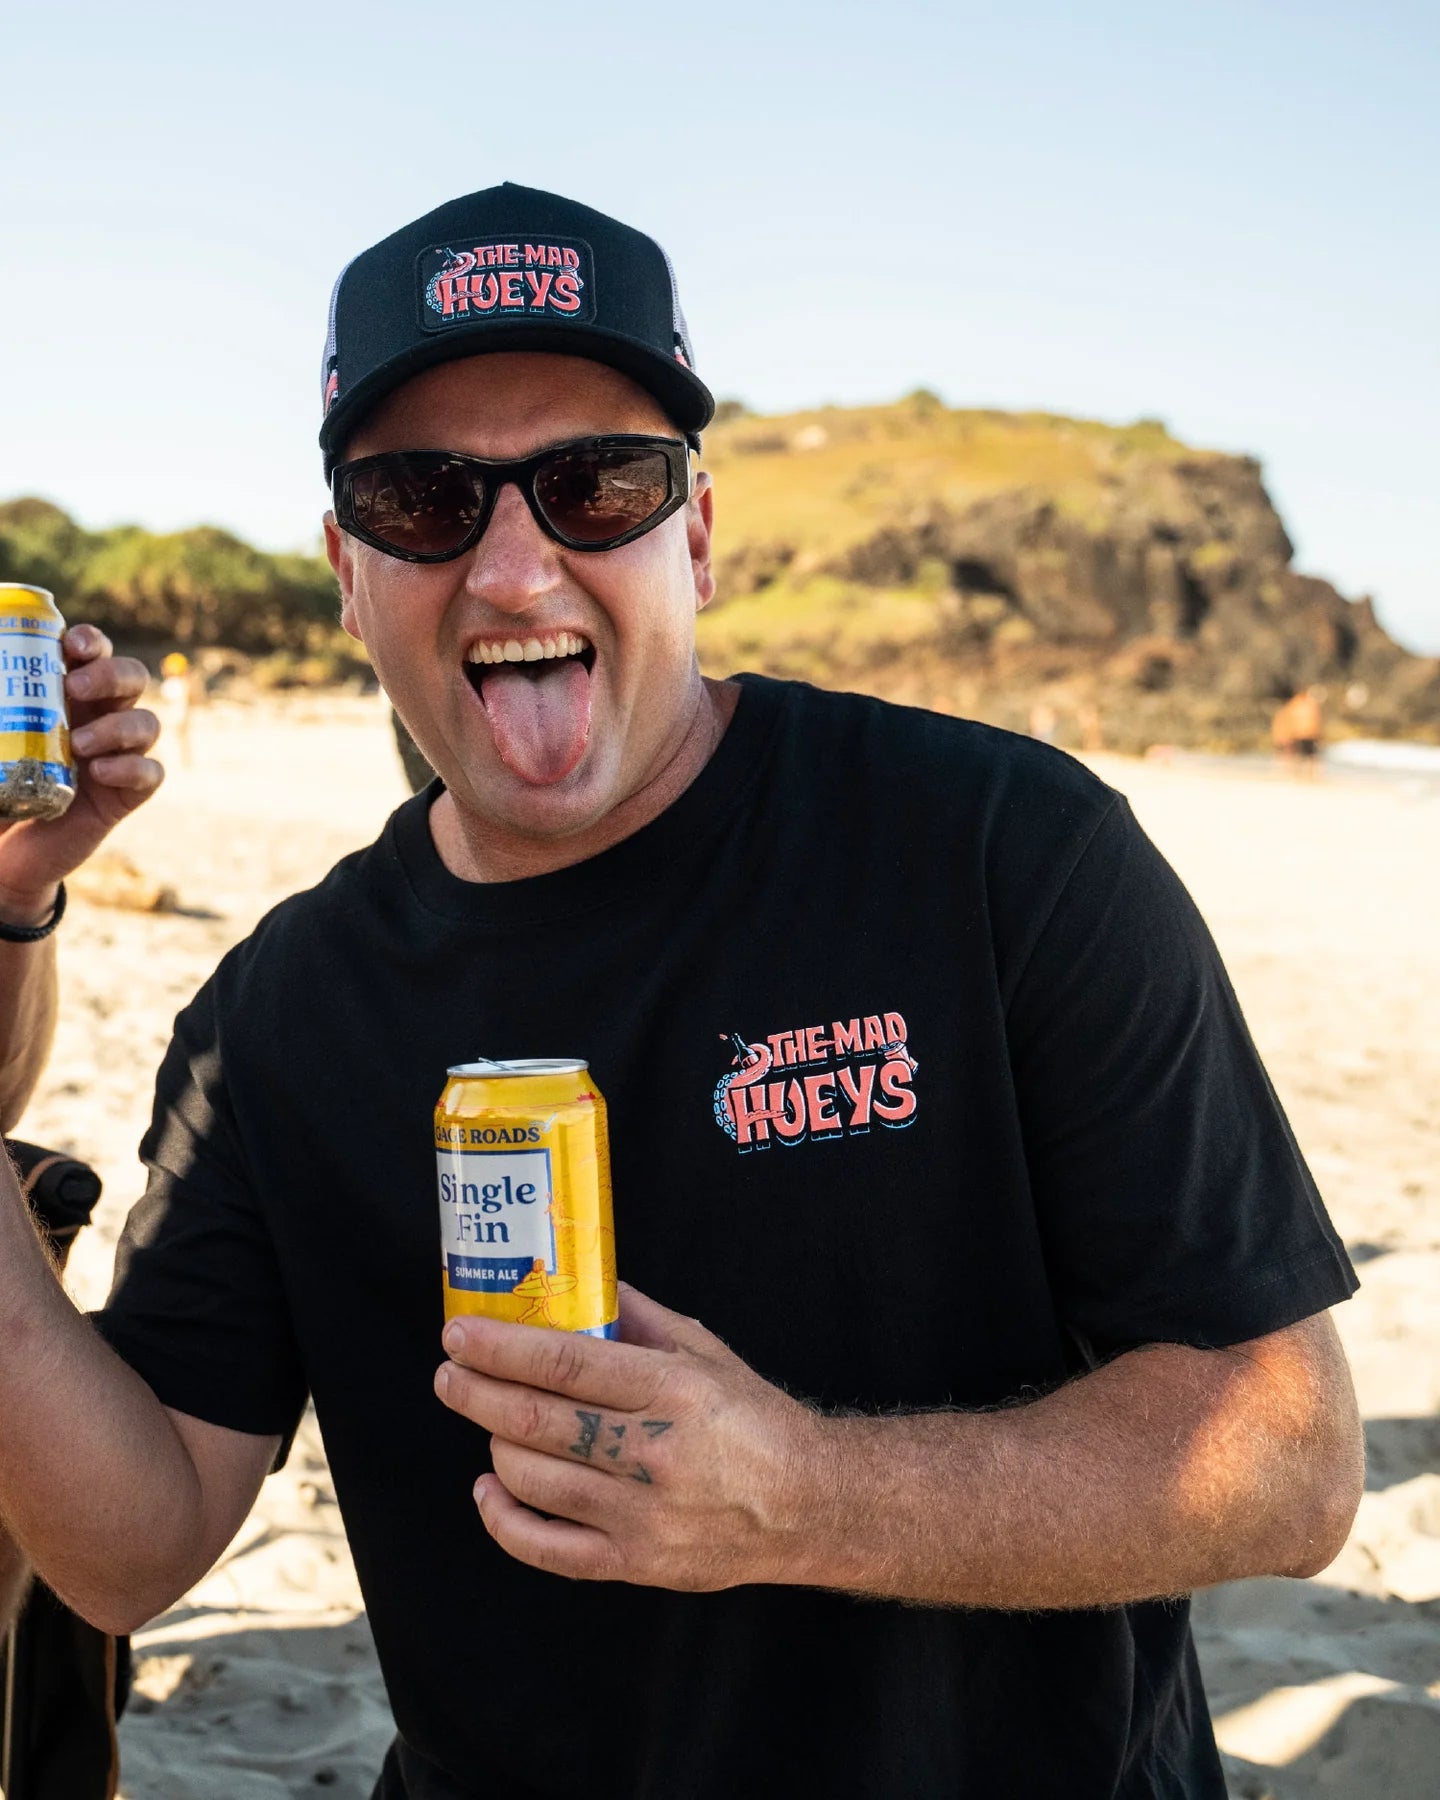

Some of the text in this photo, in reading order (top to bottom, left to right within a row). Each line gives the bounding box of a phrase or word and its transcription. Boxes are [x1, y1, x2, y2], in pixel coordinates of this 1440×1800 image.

[473, 244, 580, 269] THE MAD
[441, 271, 581, 316] HUEYS
[1, 650, 61, 677] ingle
[6, 676, 47, 698] Fin
[767, 1012, 908, 1067] THE MAD
[731, 1060, 917, 1144] HUEYS
[435, 1127, 541, 1144] GAGE ROADS
[440, 1173, 537, 1214] Single
[456, 1213, 510, 1243] Fin
[455, 1266, 519, 1280] SUMMER ALE
